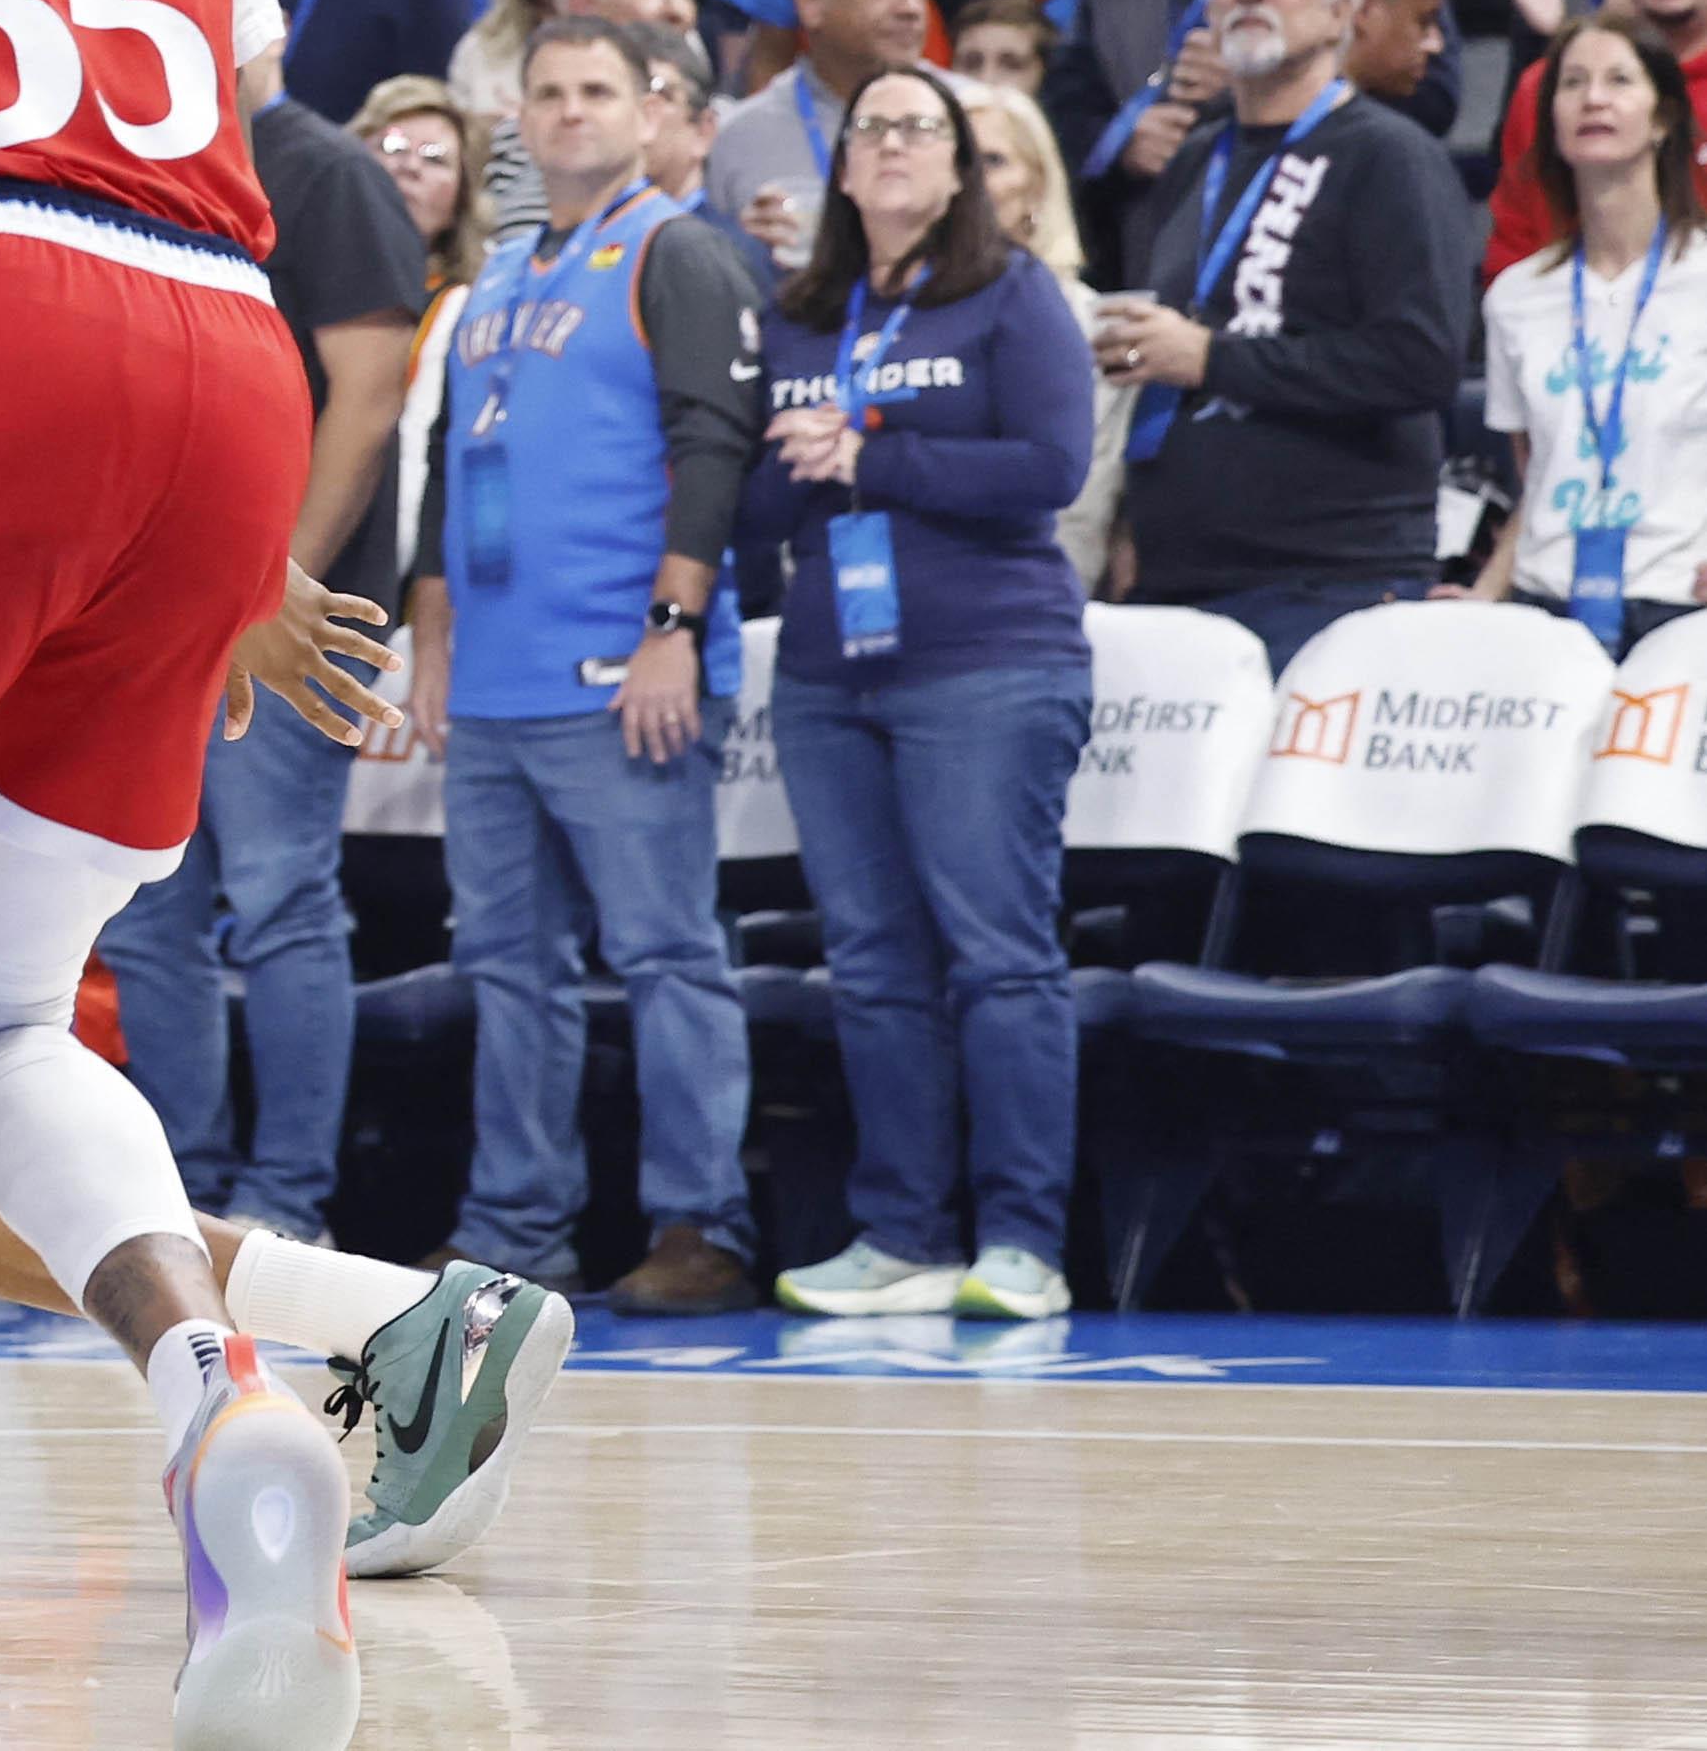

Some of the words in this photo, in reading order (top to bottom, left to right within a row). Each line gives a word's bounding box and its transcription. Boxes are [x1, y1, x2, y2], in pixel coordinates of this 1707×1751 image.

[1227, 152, 1331, 338] THUNDE
[1093, 694, 1224, 732] DFIRST
[1080, 744, 1136, 775] NK
